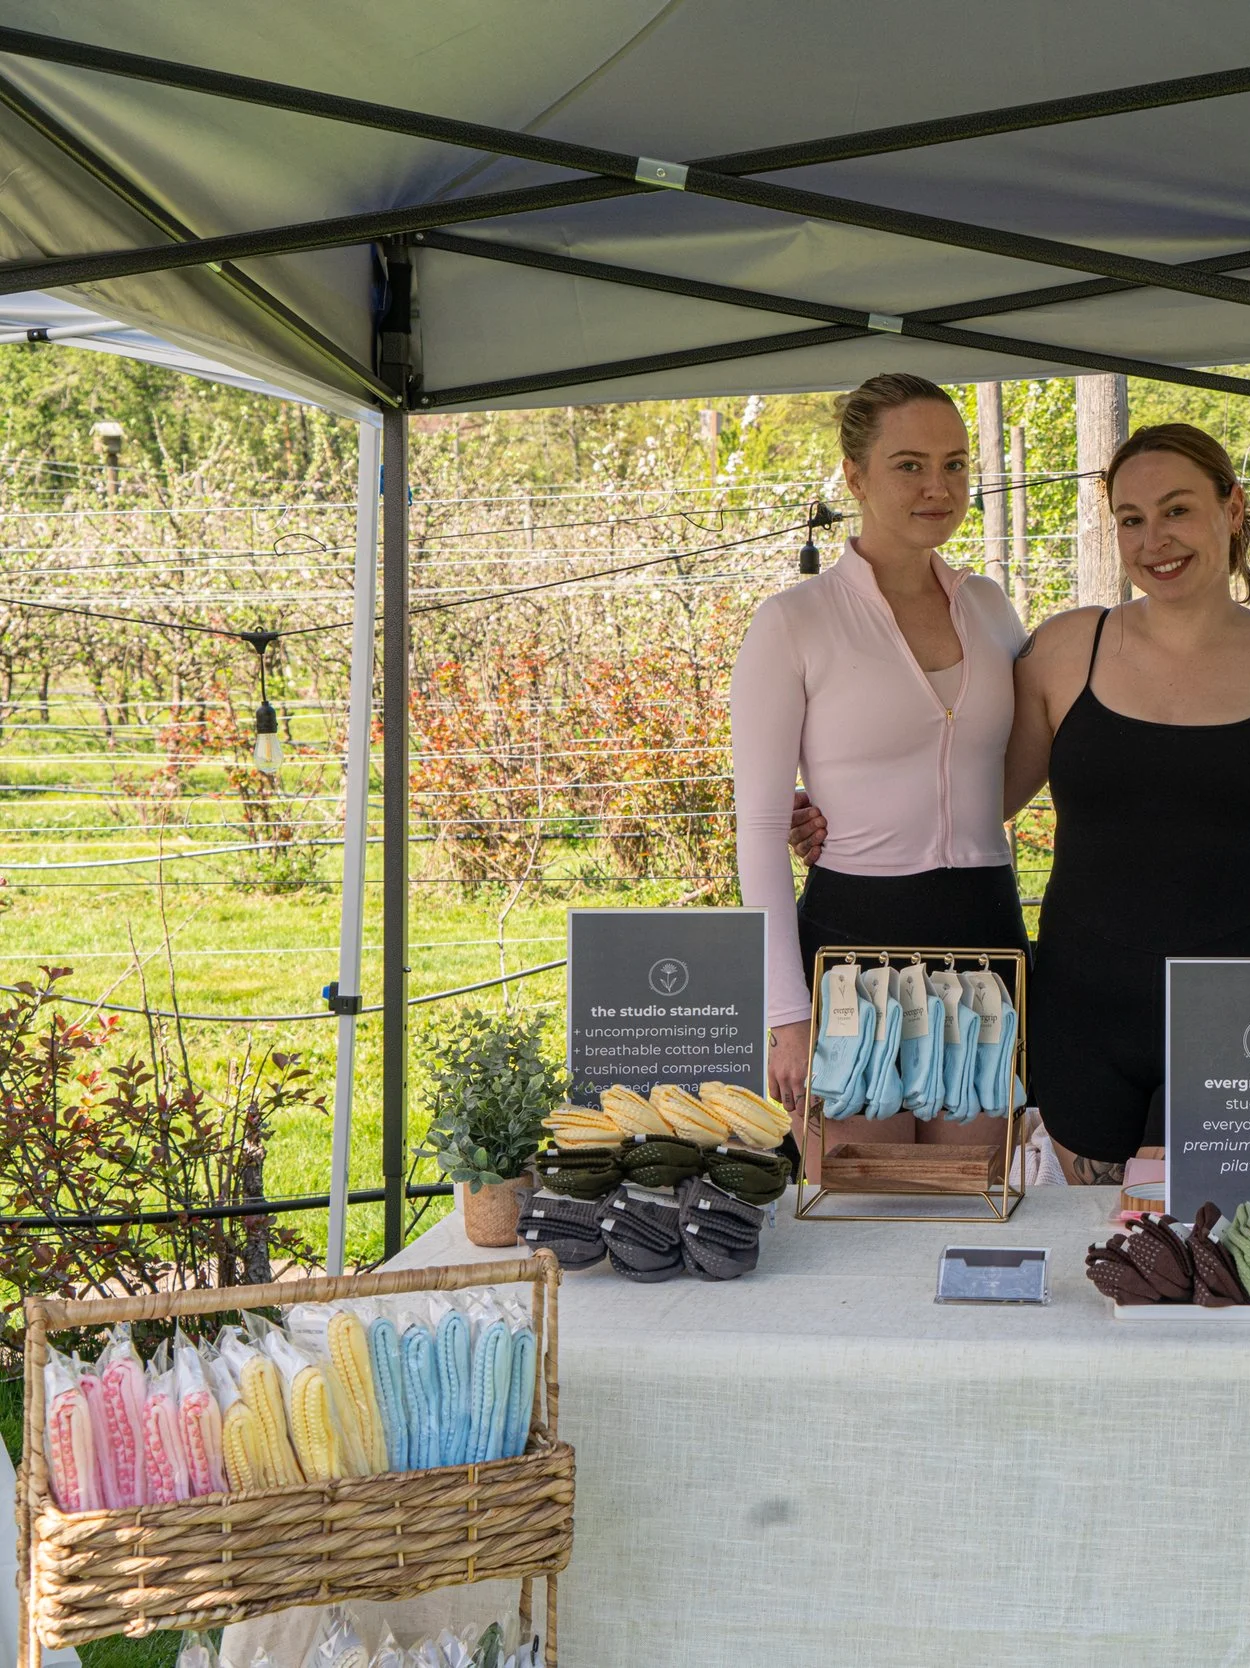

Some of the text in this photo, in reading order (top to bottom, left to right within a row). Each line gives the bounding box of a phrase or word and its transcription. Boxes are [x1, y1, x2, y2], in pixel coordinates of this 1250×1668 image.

[591, 1005, 738, 1017] the studio standard.
[586, 1025, 705, 1039] uncompromising
[710, 1025, 738, 1038] grip
[586, 1044, 661, 1056] breathable
[665, 1045, 709, 1055] cotton
[715, 1043, 753, 1054] blend
[585, 1063, 657, 1074] cushioned
[662, 1062, 750, 1075] compression
